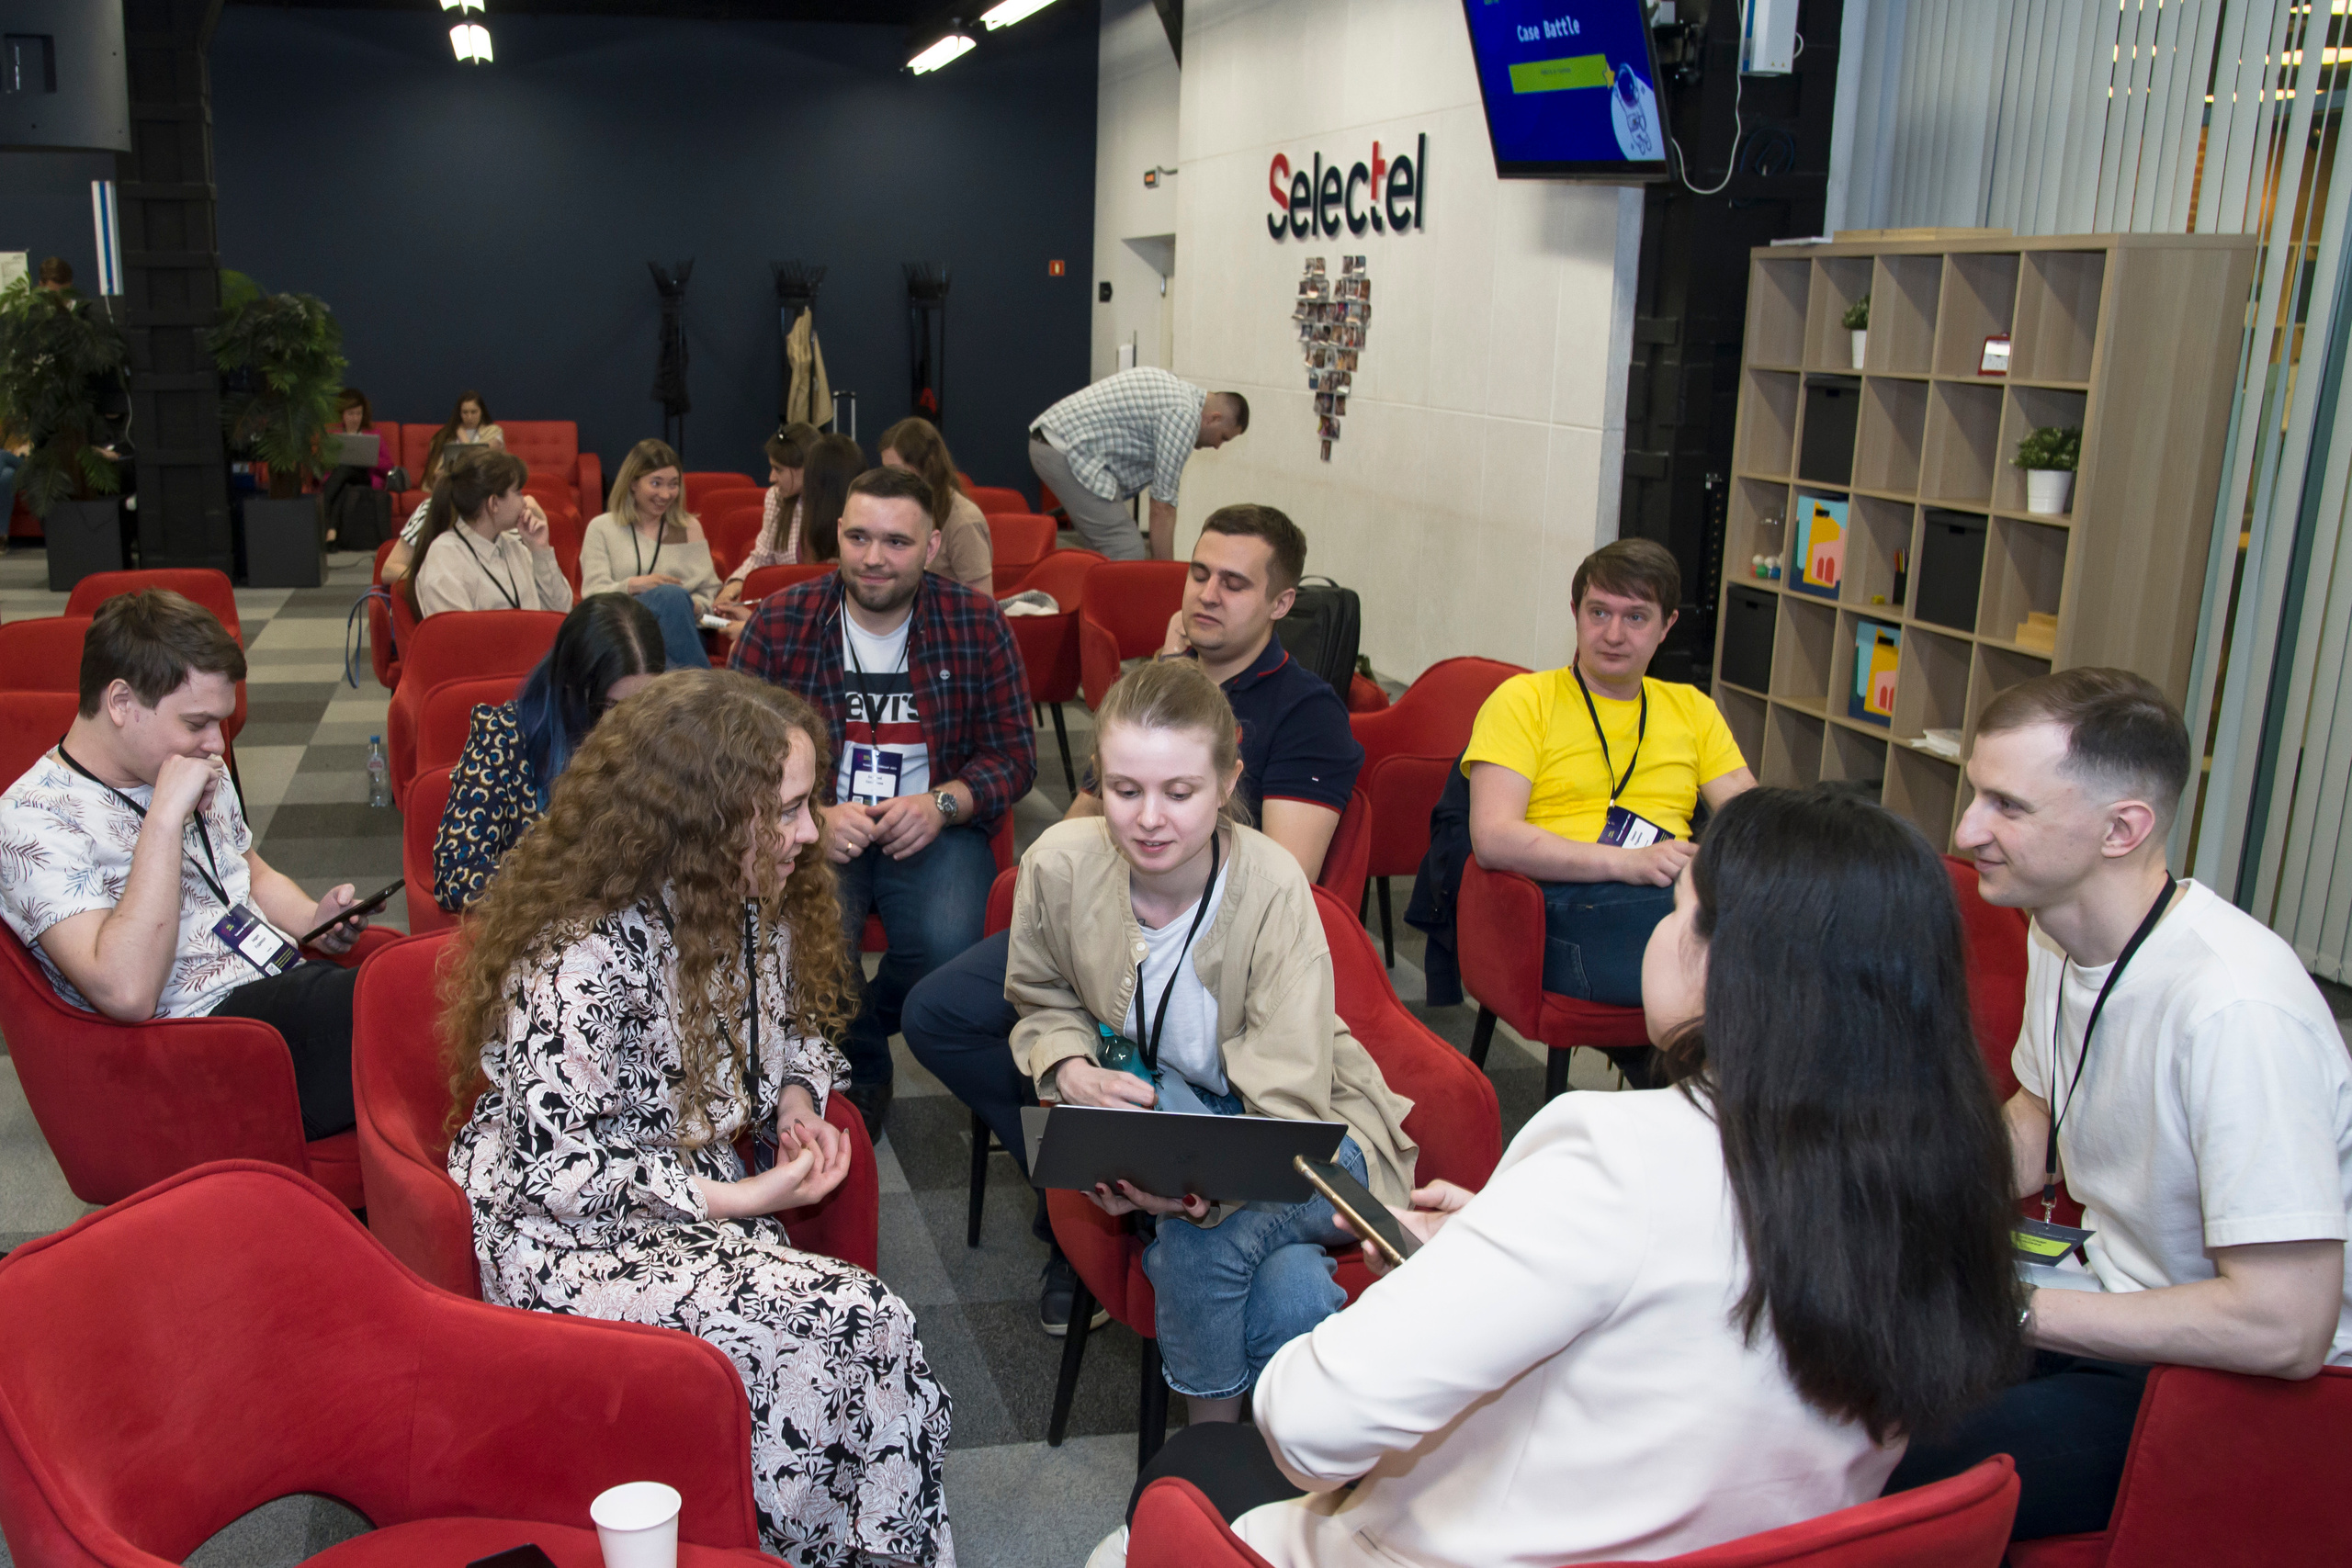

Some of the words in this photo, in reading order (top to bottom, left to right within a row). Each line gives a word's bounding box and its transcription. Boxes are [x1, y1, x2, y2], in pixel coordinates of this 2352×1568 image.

[1517, 25, 1541, 42] Case
[1543, 15, 1580, 39] Battle
[1267, 132, 1426, 240] Selectel
